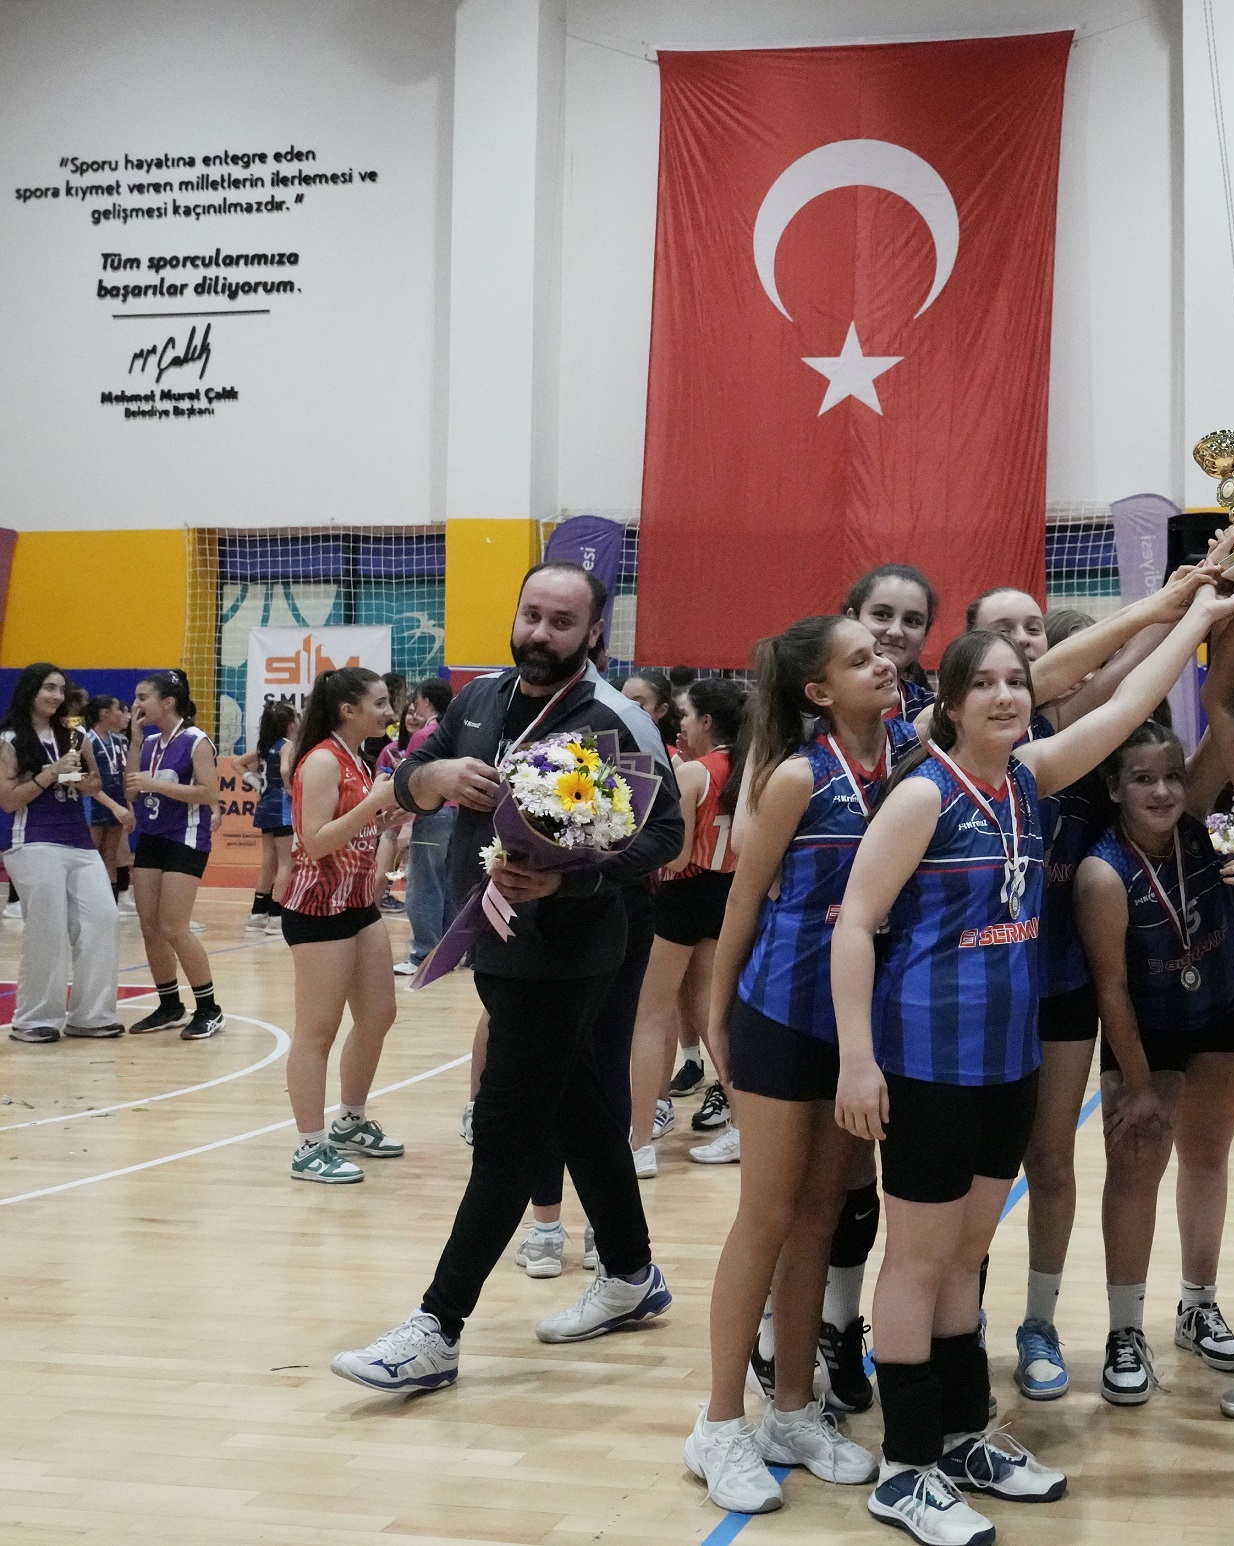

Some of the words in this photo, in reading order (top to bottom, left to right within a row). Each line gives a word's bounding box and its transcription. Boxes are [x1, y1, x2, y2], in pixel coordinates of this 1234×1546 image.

[124, 153, 196, 175] hayatına
[202, 149, 268, 170] entegre
[273, 145, 317, 163] eden
[16, 186, 60, 205] spora
[66, 179, 121, 200] kıymet
[127, 181, 174, 195] veren
[179, 173, 265, 193] milletlerin
[270, 168, 353, 188] ilerlemesi
[359, 170, 379, 183] ve
[91, 201, 167, 225] gelişmesi
[101, 252, 141, 272] Tüm
[147, 248, 300, 276] sporcularımıza
[97, 278, 188, 303] başarılar
[194, 277, 302, 301] diliyorum.
[101, 390, 156, 405] Mehmet
[160, 389, 201, 402] Murat
[124, 406, 170, 420] Belediye
[173, 405, 215, 419] Başkanı
[582, 547, 596, 572] esi
[979, 917, 1040, 946] SERM
